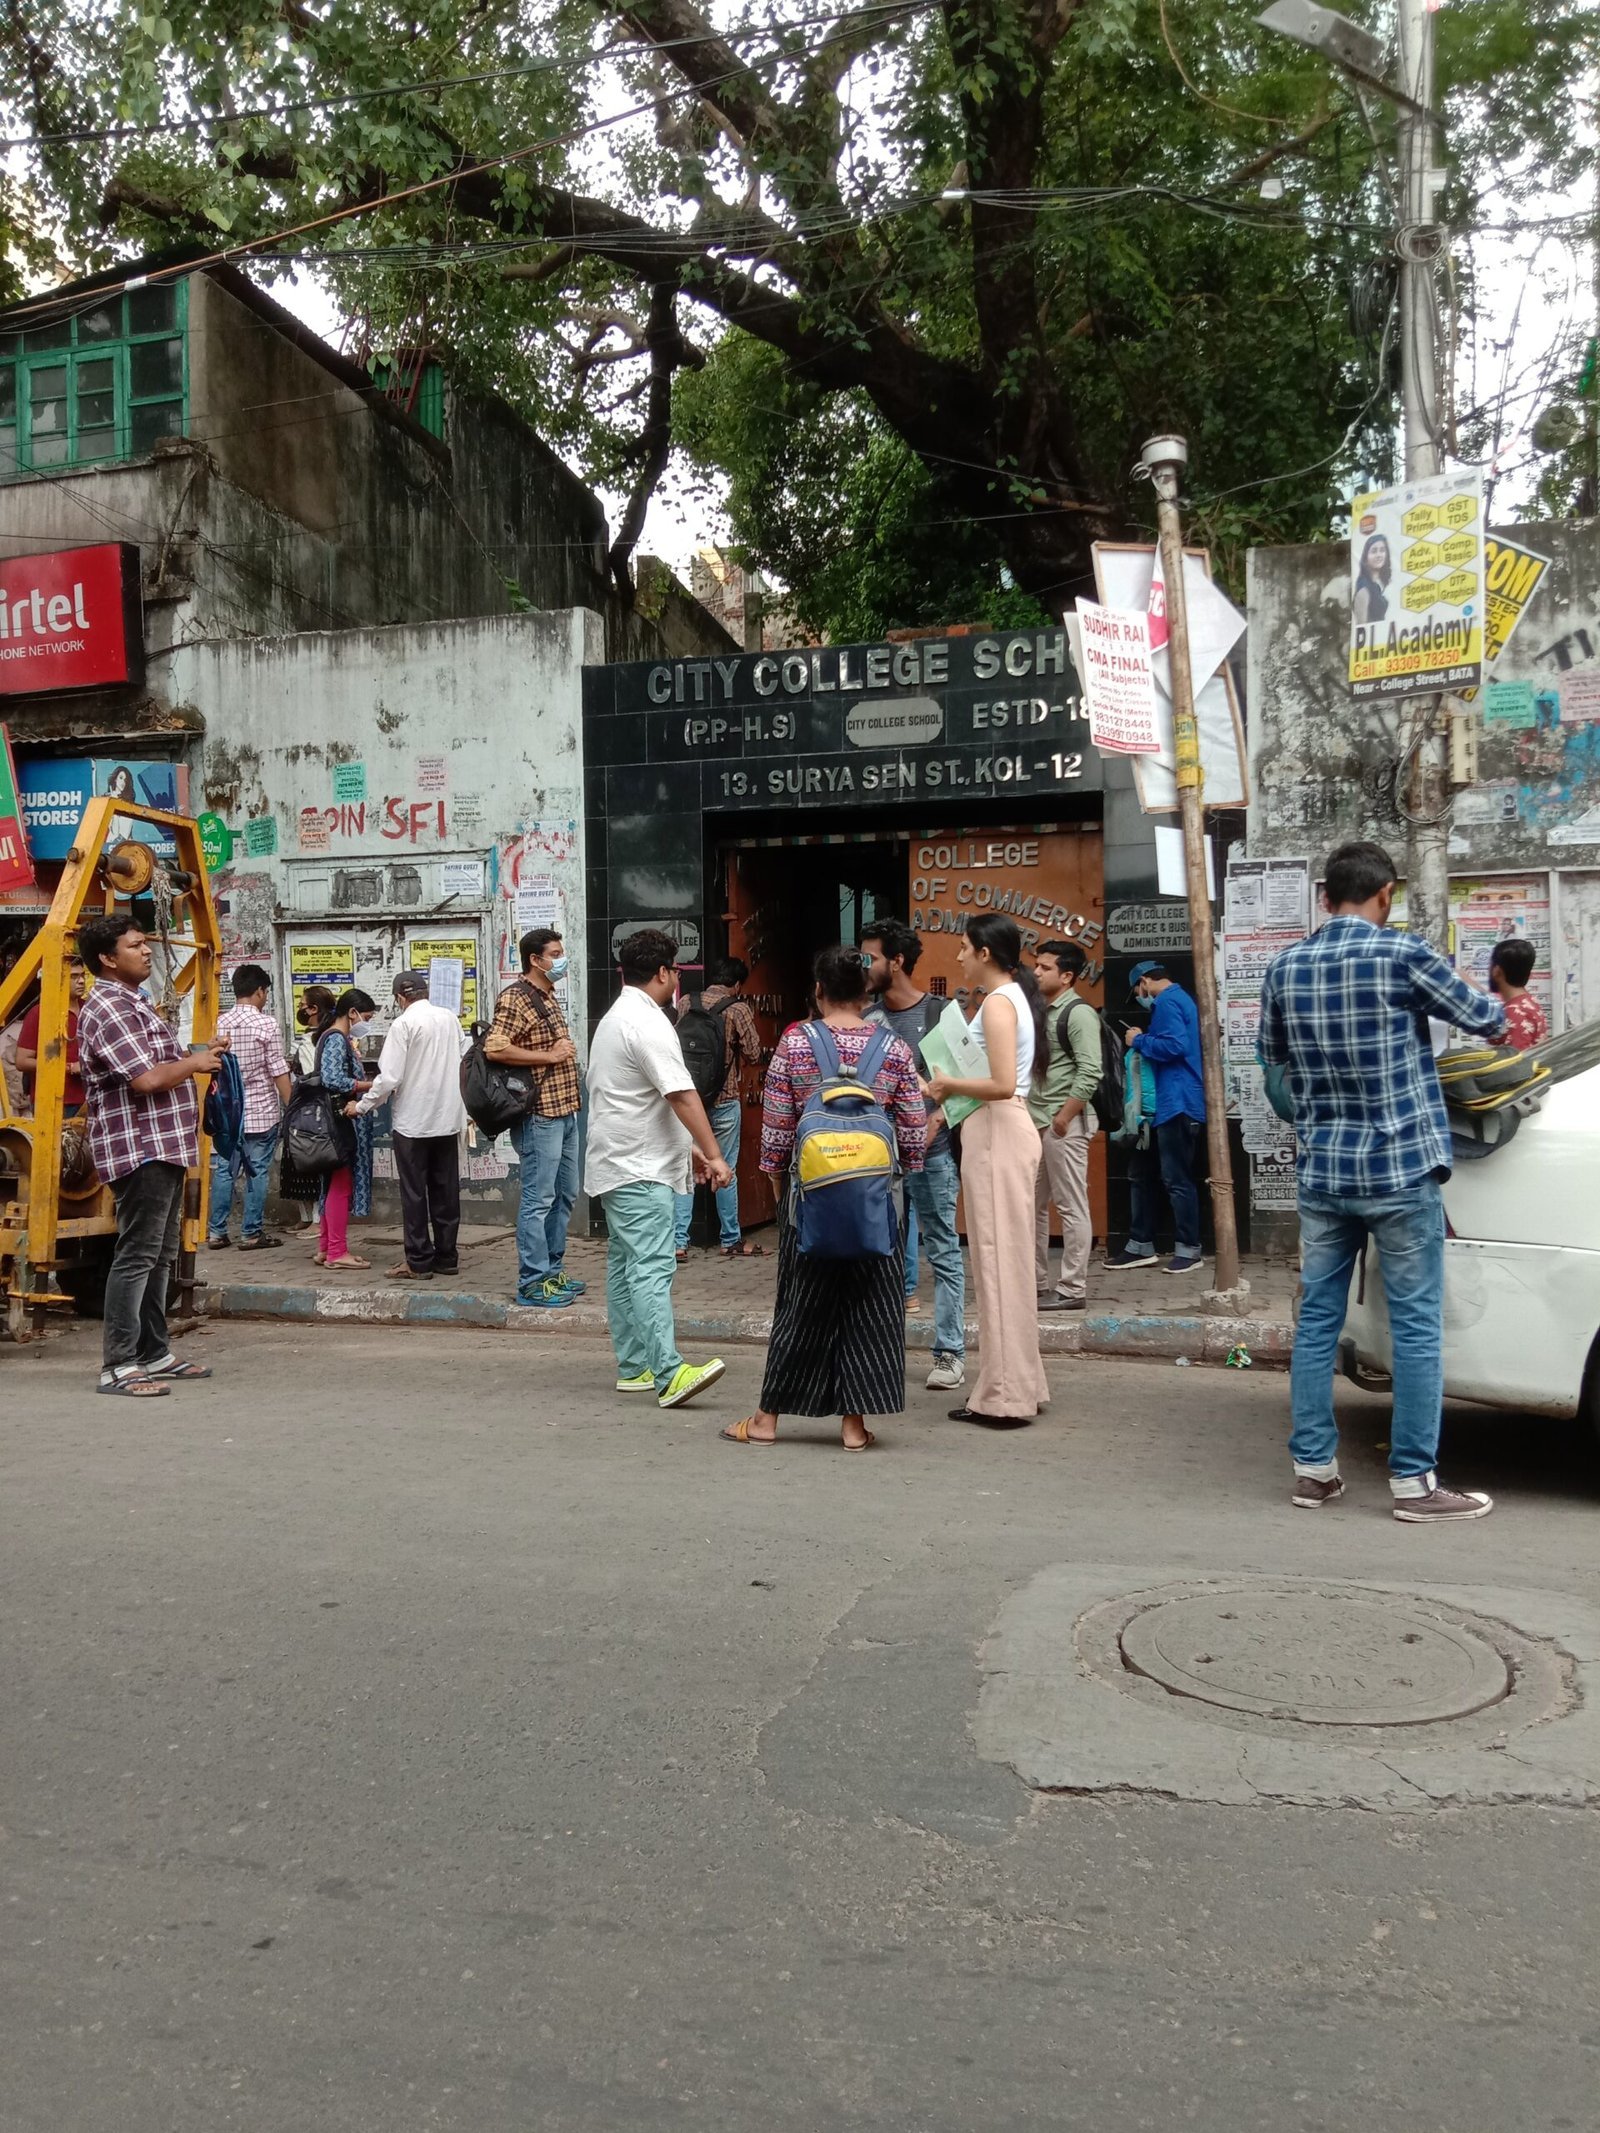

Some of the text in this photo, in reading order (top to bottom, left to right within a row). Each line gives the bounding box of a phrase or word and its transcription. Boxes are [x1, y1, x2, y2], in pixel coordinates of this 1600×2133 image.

[1447, 500, 1469, 513] GST
[1410, 511, 1432, 522] Tally
[1448, 513, 1469, 525] TDS
[1406, 522, 1435, 533] Prime
[1409, 547, 1432, 558] Adv.
[1442, 540, 1474, 552] Comp.
[1406, 557, 1436, 571] Excel
[1444, 550, 1473, 563] Basic
[1449, 574, 1466, 586] DTP
[1406, 583, 1435, 597] Spoken
[1440, 586, 1476, 601] Graphics
[1406, 593, 1437, 609] English
[1083, 614, 1145, 643] SUDHIR RAI
[28, 640, 86, 657] NETWORK
[1087, 648, 1150, 673] CMA FINAL
[1353, 663, 1375, 678] Call
[1385, 656, 1421, 674] 93309
[1425, 650, 1460, 667] 78250
[647, 633, 1076, 704] CITY COLLEGE SCH
[1111, 672, 1150, 687] Subjects)
[1353, 681, 1374, 695] Near
[1380, 674, 1414, 692] College
[1448, 666, 1474, 680] BATA
[972, 695, 1090, 730] ESTD-18
[847, 714, 941, 731] CITY COLLEGE SCHOOL
[720, 771, 758, 797] 13,
[767, 766, 855, 795] SURYA
[861, 761, 917, 791] SEN
[20, 790, 83, 807] SUBODH
[24, 810, 80, 827] STORES
[380, 797, 447, 844] SFI
[917, 841, 1039, 870] COLLEGE
[4, 906, 47, 914] RECHARGE
[912, 876, 1104, 948] OF COMMERCE
[1144, 907, 1185, 919] COLLEGE
[1108, 921, 1191, 935] COMMERCE & BUSI
[1123, 935, 1191, 948] ADMINISTRATIO
[1256, 1164, 1295, 1173] BOYS
